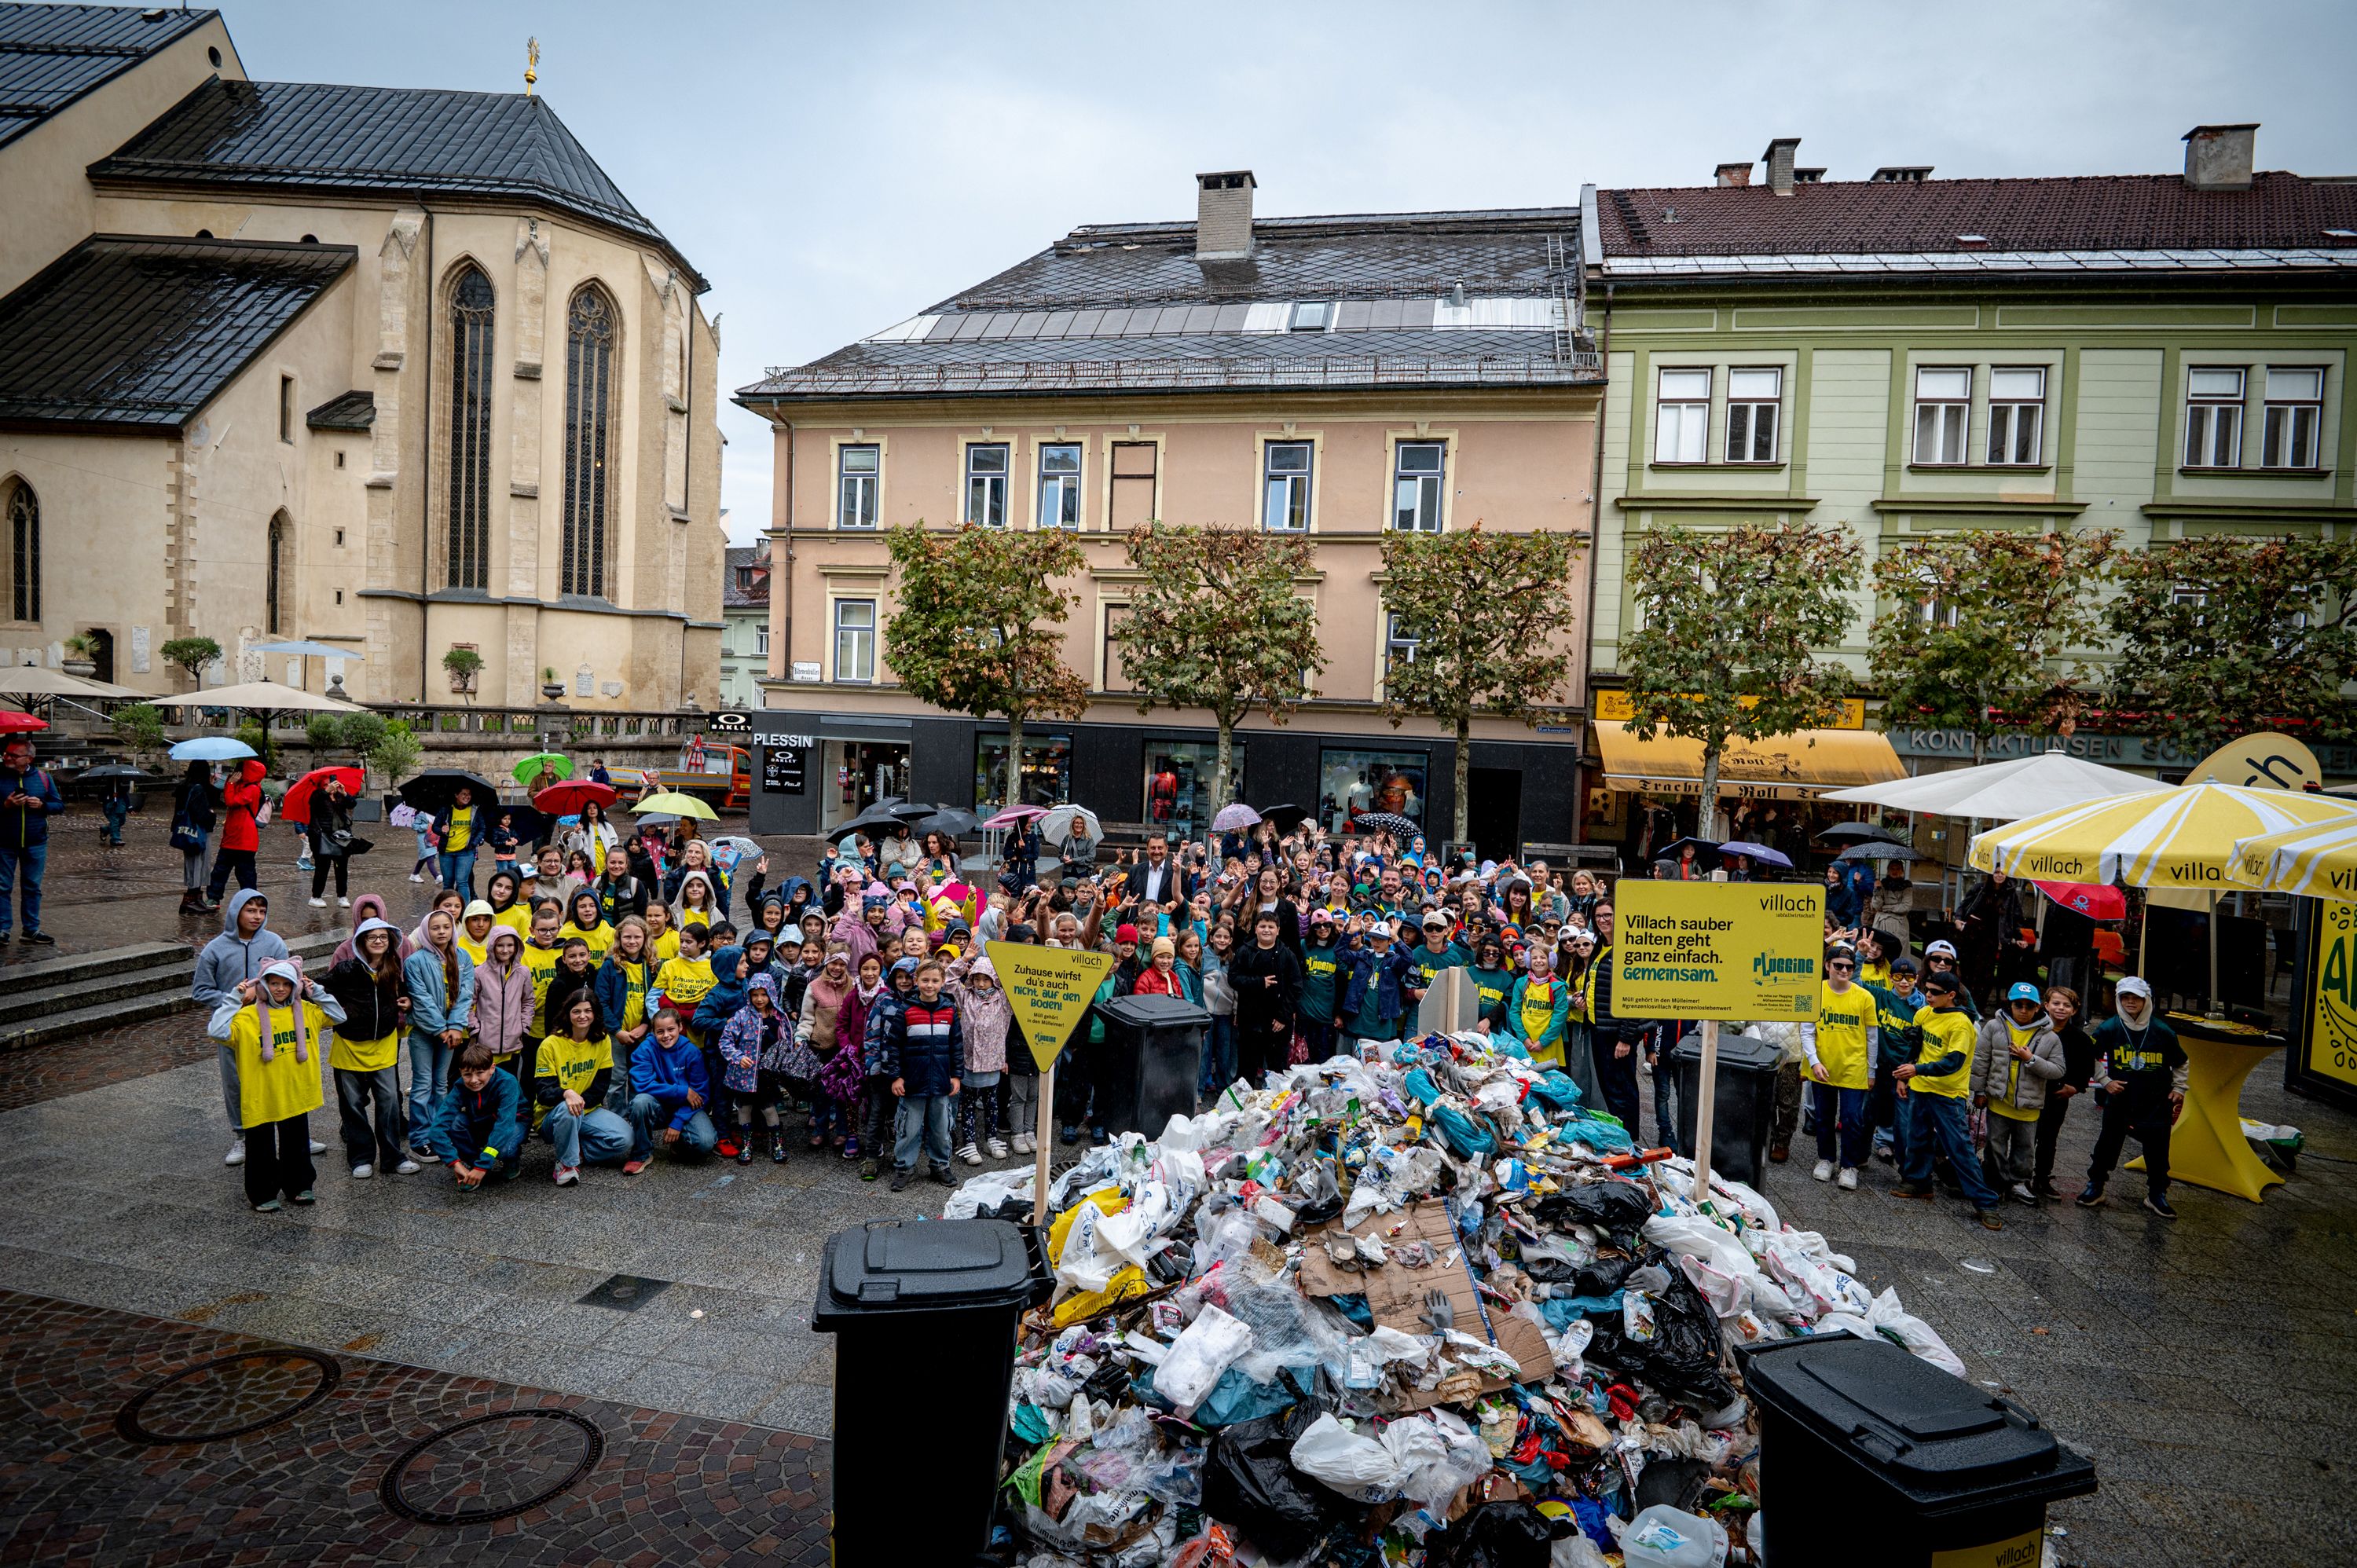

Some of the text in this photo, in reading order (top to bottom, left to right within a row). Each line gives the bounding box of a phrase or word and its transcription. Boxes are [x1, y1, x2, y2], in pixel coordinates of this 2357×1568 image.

[754, 733, 814, 748] PLESSIN
[1739, 786, 1778, 799] Roll
[2030, 856, 2083, 876] villach
[1760, 894, 1816, 911] villach
[1626, 914, 1733, 931] Villach sauber
[1625, 931, 1711, 950] halten geht
[1071, 953, 1102, 966] villach
[1624, 949, 1723, 965] ganz einfach.
[1014, 964, 1082, 981] Zuhause wirfst
[1014, 984, 1080, 1002] nicht auf den
[1047, 980, 1069, 991] auch
[1164, 1311, 1178, 1320] skyr
[1996, 1541, 2035, 1568] villach
